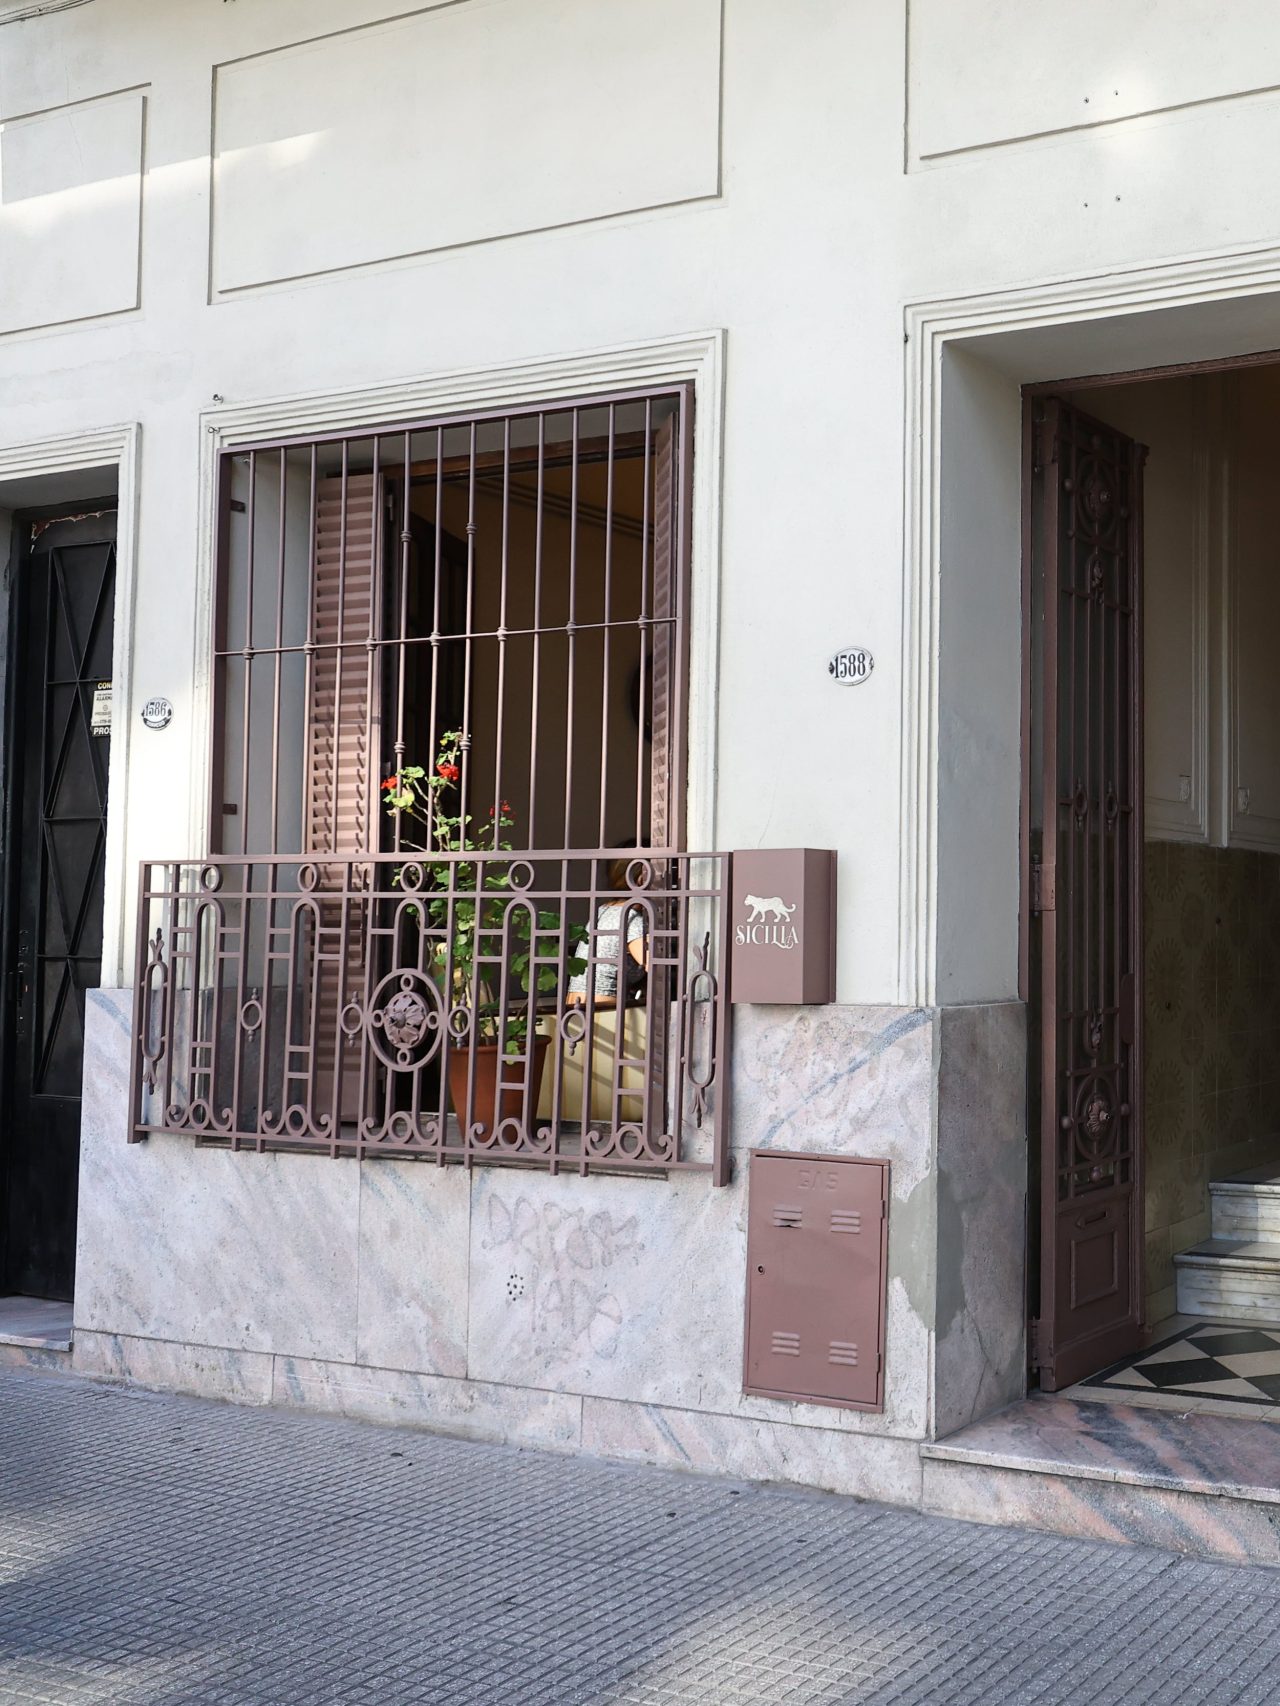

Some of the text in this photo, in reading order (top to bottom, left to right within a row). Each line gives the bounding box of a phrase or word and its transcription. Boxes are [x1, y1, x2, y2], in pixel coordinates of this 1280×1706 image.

[834, 652, 866, 679] 1588
[97, 682, 112, 690] CON
[145, 701, 168, 717] 1586
[735, 924, 799, 949] SICILIA
